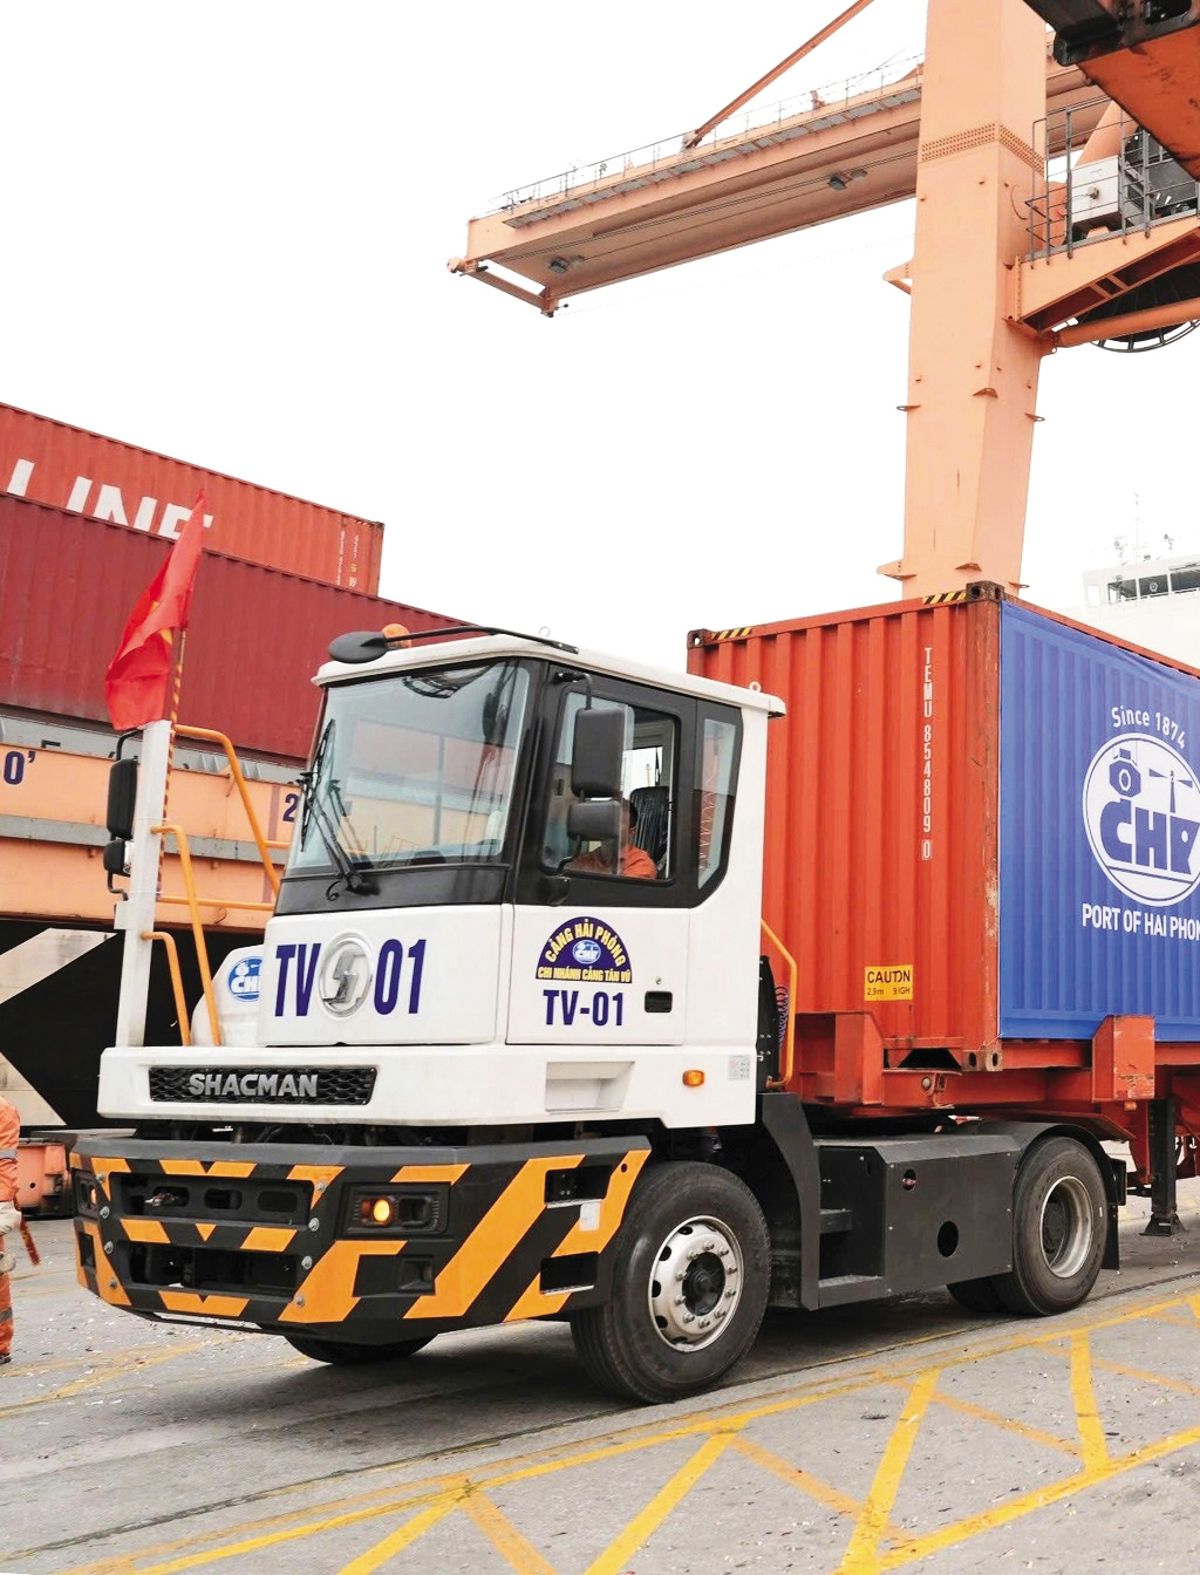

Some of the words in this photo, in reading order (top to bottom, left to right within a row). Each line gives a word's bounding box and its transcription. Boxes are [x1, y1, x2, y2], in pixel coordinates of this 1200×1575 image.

[1111, 705, 1150, 728] Since
[1155, 712, 1185, 749] 1874
[1082, 903, 1121, 931] PORT
[1123, 910, 1142, 933] OF
[1144, 912, 1167, 937] HAI
[545, 927, 574, 963] CẢNG
[574, 918, 594, 939] HẢI
[275, 943, 321, 1017] TV
[374, 938, 426, 1015] 01
[543, 989, 623, 1026] TV-01
[189, 1073, 318, 1097] SHACMAN
